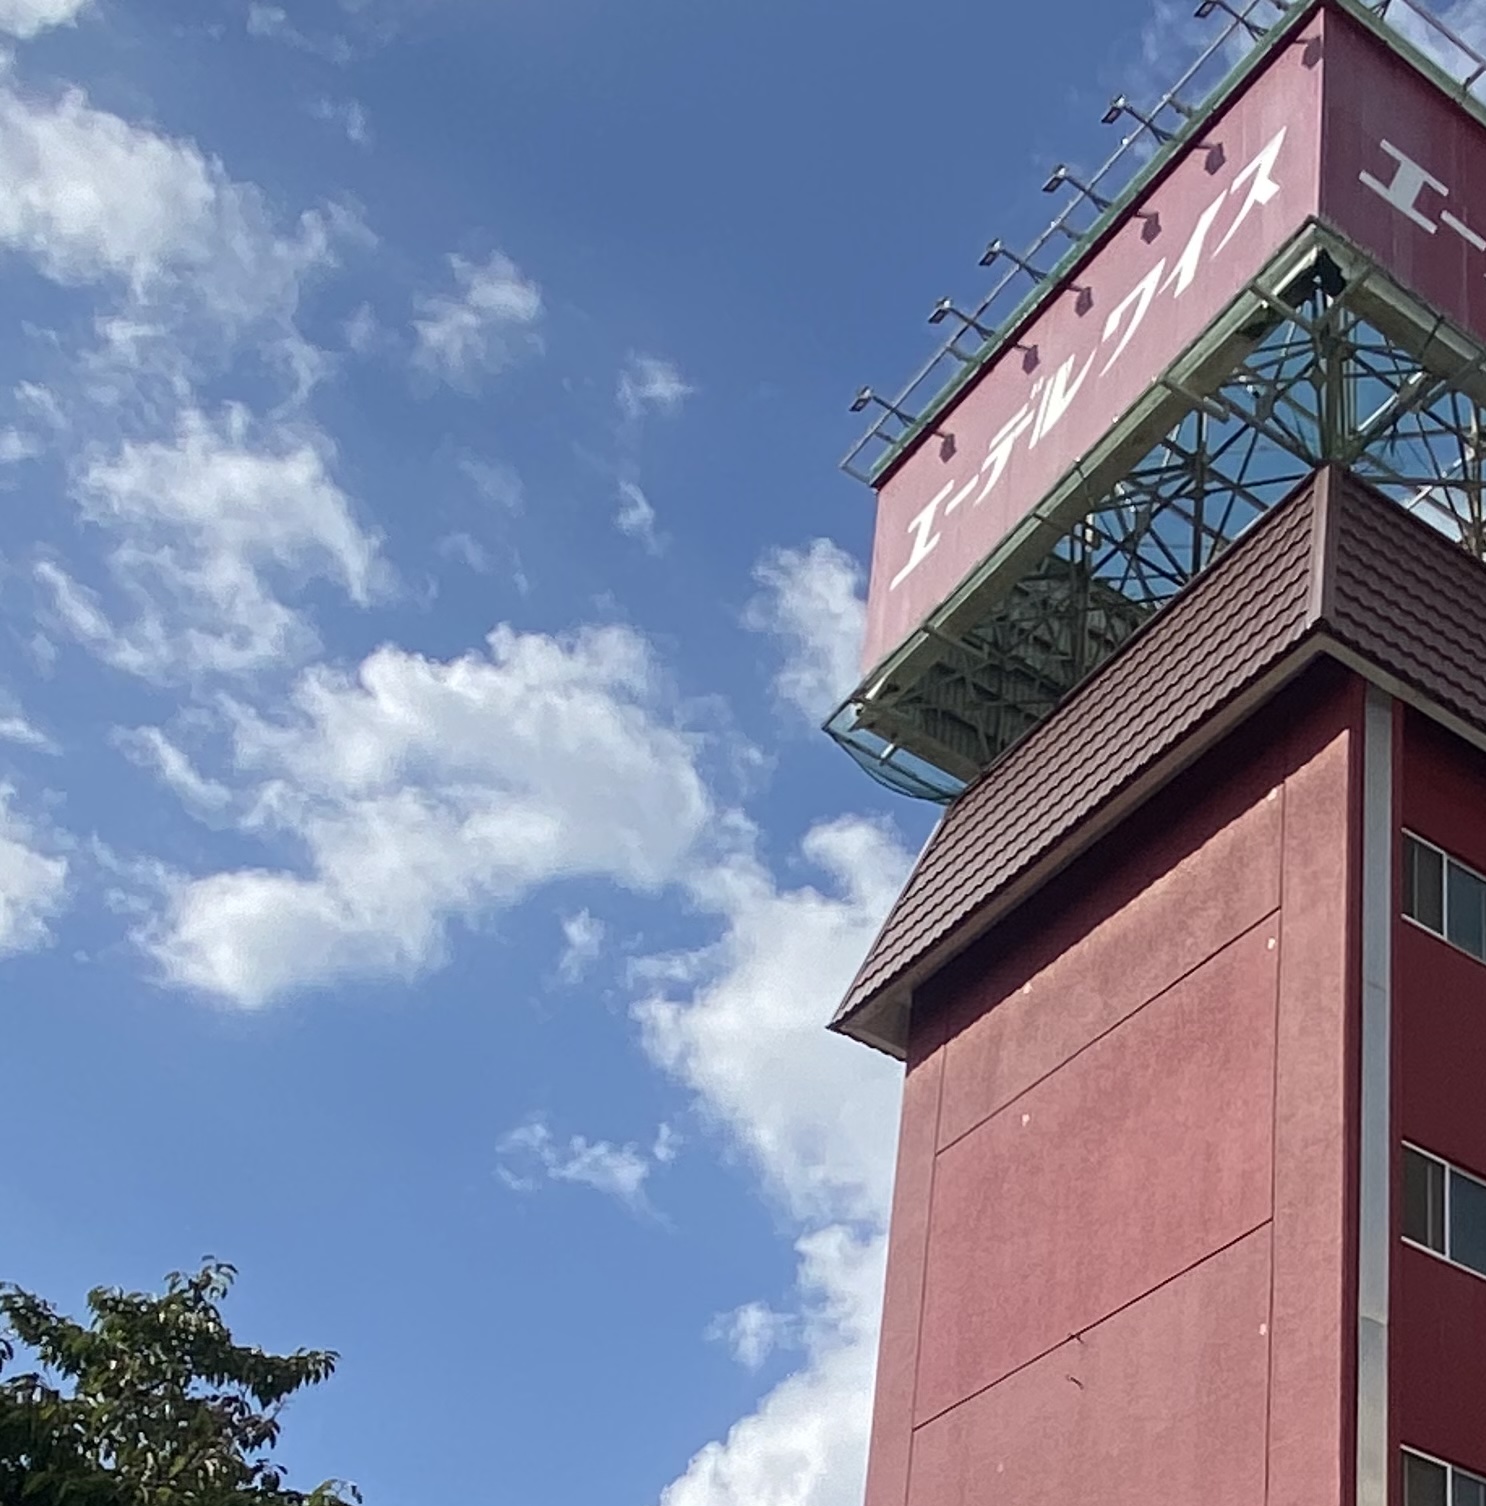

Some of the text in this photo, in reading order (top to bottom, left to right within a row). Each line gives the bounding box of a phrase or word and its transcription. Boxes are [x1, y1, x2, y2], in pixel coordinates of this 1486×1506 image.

[889, 125, 1286, 592] エーデルワイス
